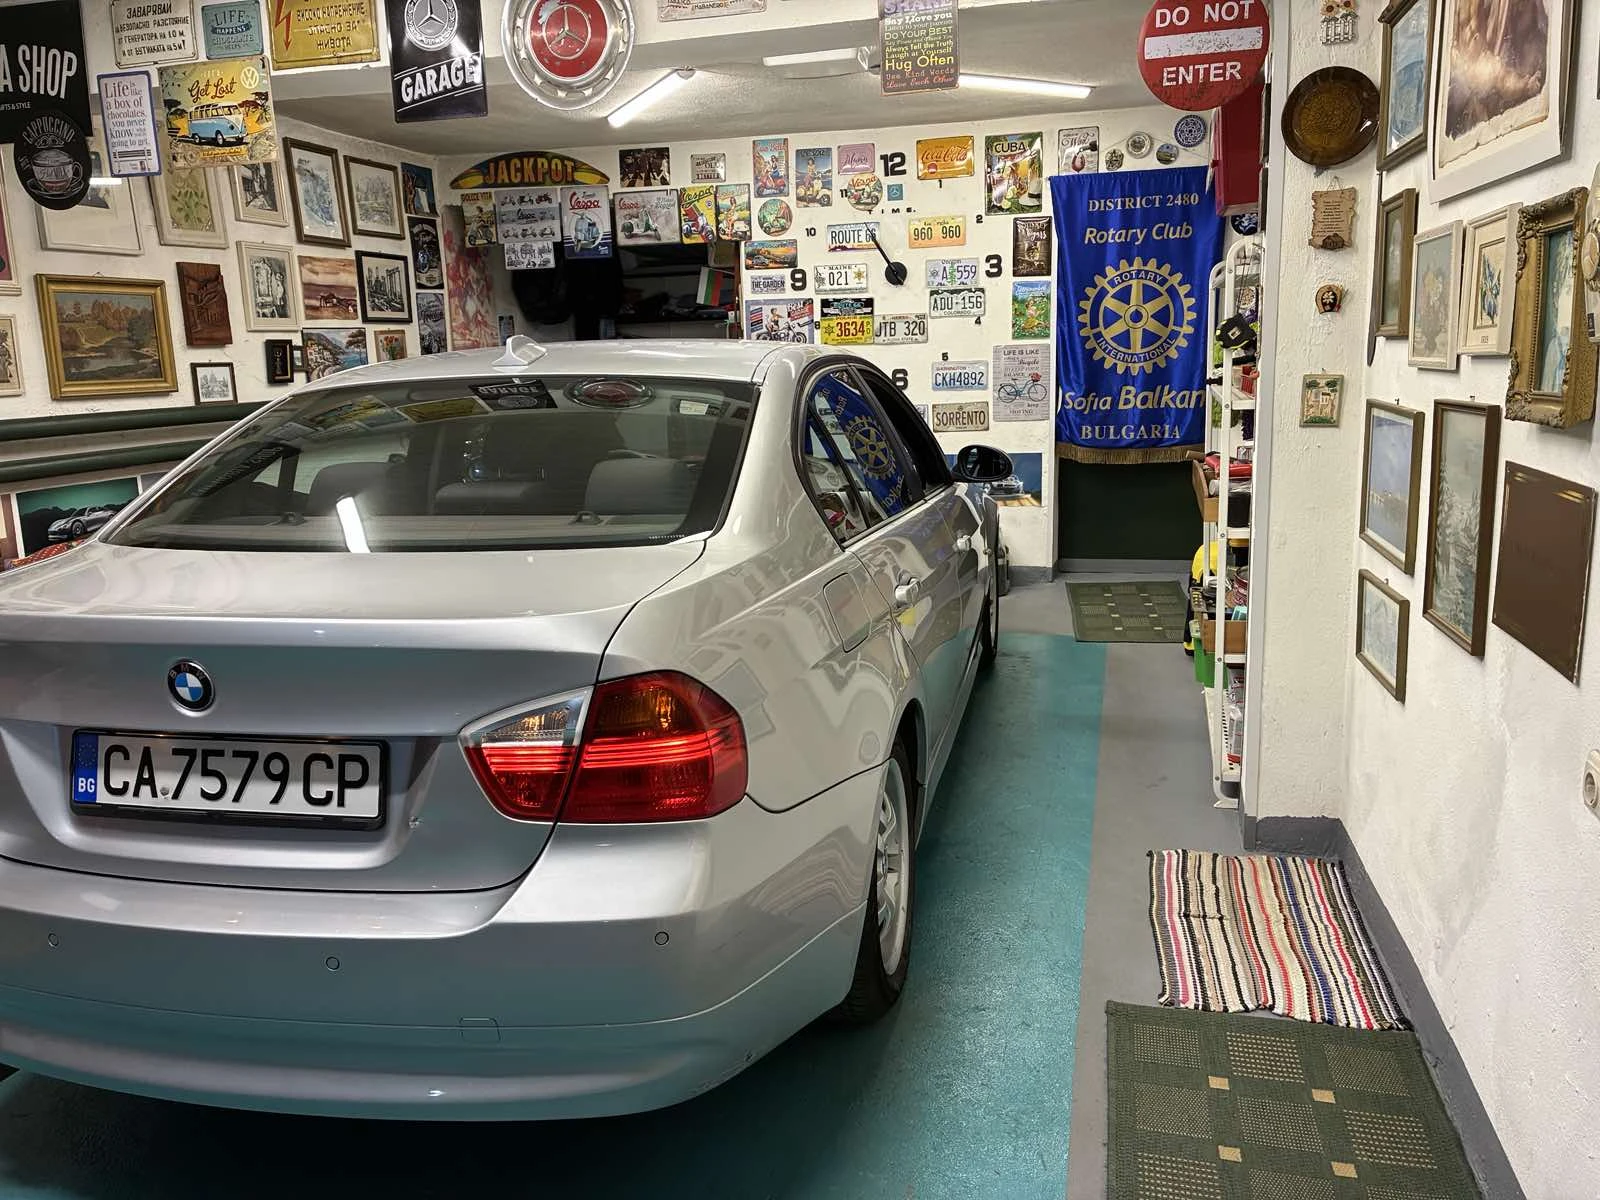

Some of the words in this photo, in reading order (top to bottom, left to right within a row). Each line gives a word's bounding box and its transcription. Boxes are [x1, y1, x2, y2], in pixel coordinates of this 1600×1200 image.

[214, 10, 246, 26] LIFE
[933, 13, 953, 21] you
[1155, 6, 1190, 28] DO
[1204, 0, 1250, 23] NOT
[168, 30, 177, 38] 10
[216, 26, 246, 34] HAPPENS
[308, 23, 343, 36] ОПАСНО
[884, 32, 899, 40] DO
[901, 29, 927, 38] YOUR
[929, 26, 953, 35] BEST
[316, 36, 352, 50] ЖИВОТА
[886, 51, 909, 60] Laugh
[921, 47, 953, 55] Yourself
[885, 59, 912, 72] Hug
[917, 53, 954, 67] Often
[18, 45, 78, 99] SHOP
[401, 55, 483, 104] GARAGE
[1162, 61, 1242, 87] ENTER
[104, 80, 129, 98] Life
[187, 80, 212, 103] Get
[211, 76, 237, 99] Lost
[16, 101, 31, 109] STYLE
[106, 102, 112, 111] a
[114, 98, 131, 109] box
[133, 96, 143, 107] of
[22, 115, 77, 145] CAPPUCCINO
[112, 120, 125, 128] you
[126, 118, 146, 127] never
[110, 128, 133, 139] know
[111, 140, 129, 148] going
[129, 138, 136, 146] to
[995, 141, 1027, 153] CUBA
[483, 157, 576, 184] JACKPOT
[880, 152, 907, 177] 12
[569, 191, 601, 210] Vespa
[618, 197, 641, 210] Vespa
[681, 185, 714, 208] Vespa
[1088, 195, 1162, 212] DISTRICT
[1166, 192, 1200, 207] 2480
[976, 214, 984, 224] 2
[805, 227, 817, 237] 10
[830, 229, 863, 245] ROUTE
[865, 227, 877, 243] 66
[913, 226, 933, 241] 960
[941, 224, 961, 239] 960
[1084, 226, 1147, 245] Rotary
[1151, 221, 1193, 239] Club
[828, 263, 853, 271] MAINE
[942, 266, 948, 281] A
[956, 265, 977, 280] 559
[985, 254, 1003, 278] 3
[762, 279, 786, 288] GARDEN
[790, 268, 808, 291] 9
[828, 270, 849, 286] 021
[1113, 269, 1164, 285] ROTARY
[814, 320, 821, 330] 8
[975, 315, 982, 325] 4
[836, 321, 866, 337] 3634
[874, 321, 897, 337] JTB
[903, 320, 926, 336] 320
[941, 351, 949, 361] 5
[1097, 336, 1176, 363] INTERNATIONAL
[891, 368, 909, 391] 6
[934, 371, 985, 388] CKH4892
[1064, 391, 1112, 415] Sofia
[1118, 385, 1205, 410] Balkan
[935, 410, 986, 427] SORRENTO
[1080, 424, 1181, 440] BULGARIA
[103, 744, 159, 799] CA
[171, 747, 290, 805] 7579
[302, 752, 370, 808] CP
[77, 777, 96, 793] BG
